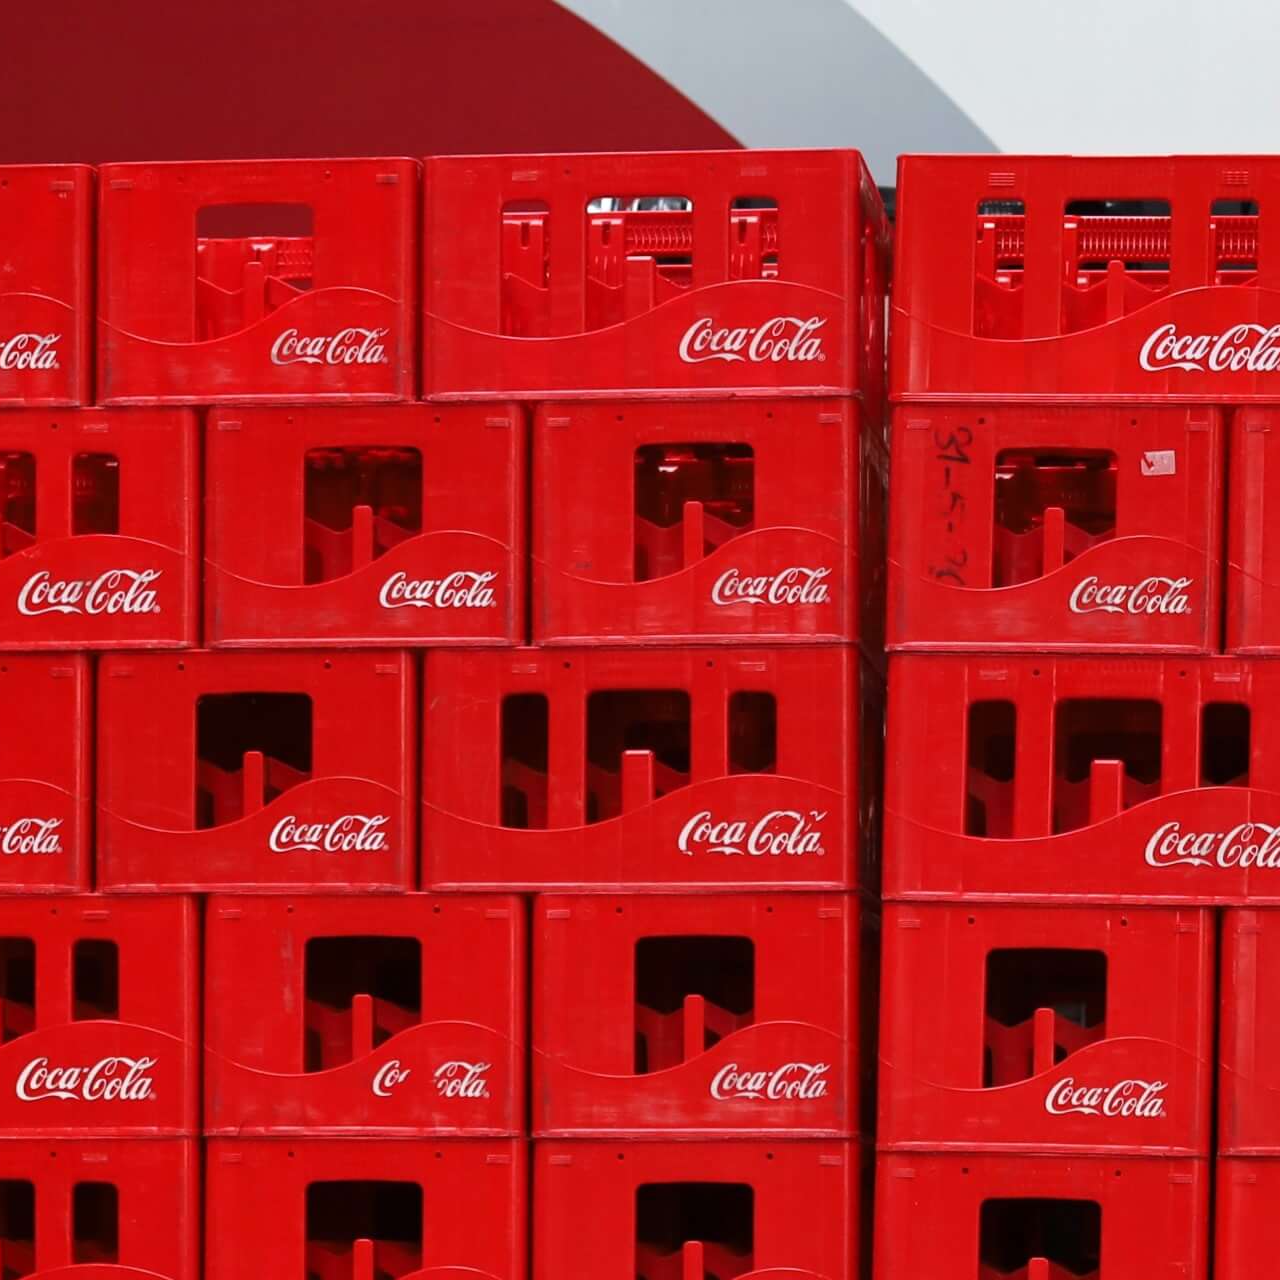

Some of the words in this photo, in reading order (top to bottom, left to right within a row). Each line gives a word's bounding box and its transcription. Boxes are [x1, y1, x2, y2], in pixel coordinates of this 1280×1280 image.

[271, 328, 388, 365] Coca-Cola
[679, 317, 827, 362] Coca-Cola
[17, 569, 162, 615] Coca-Cola
[379, 571, 497, 608] Coca-Cola
[712, 567, 832, 606] Coca-Cola
[1069, 576, 1193, 614] Coca-Cola
[269, 815, 390, 852] Coca-Cola
[16, 1057, 157, 1101] Coca-Cola
[710, 1063, 830, 1101] Coca-Cola
[1045, 1077, 1168, 1117] Coca-Cola
